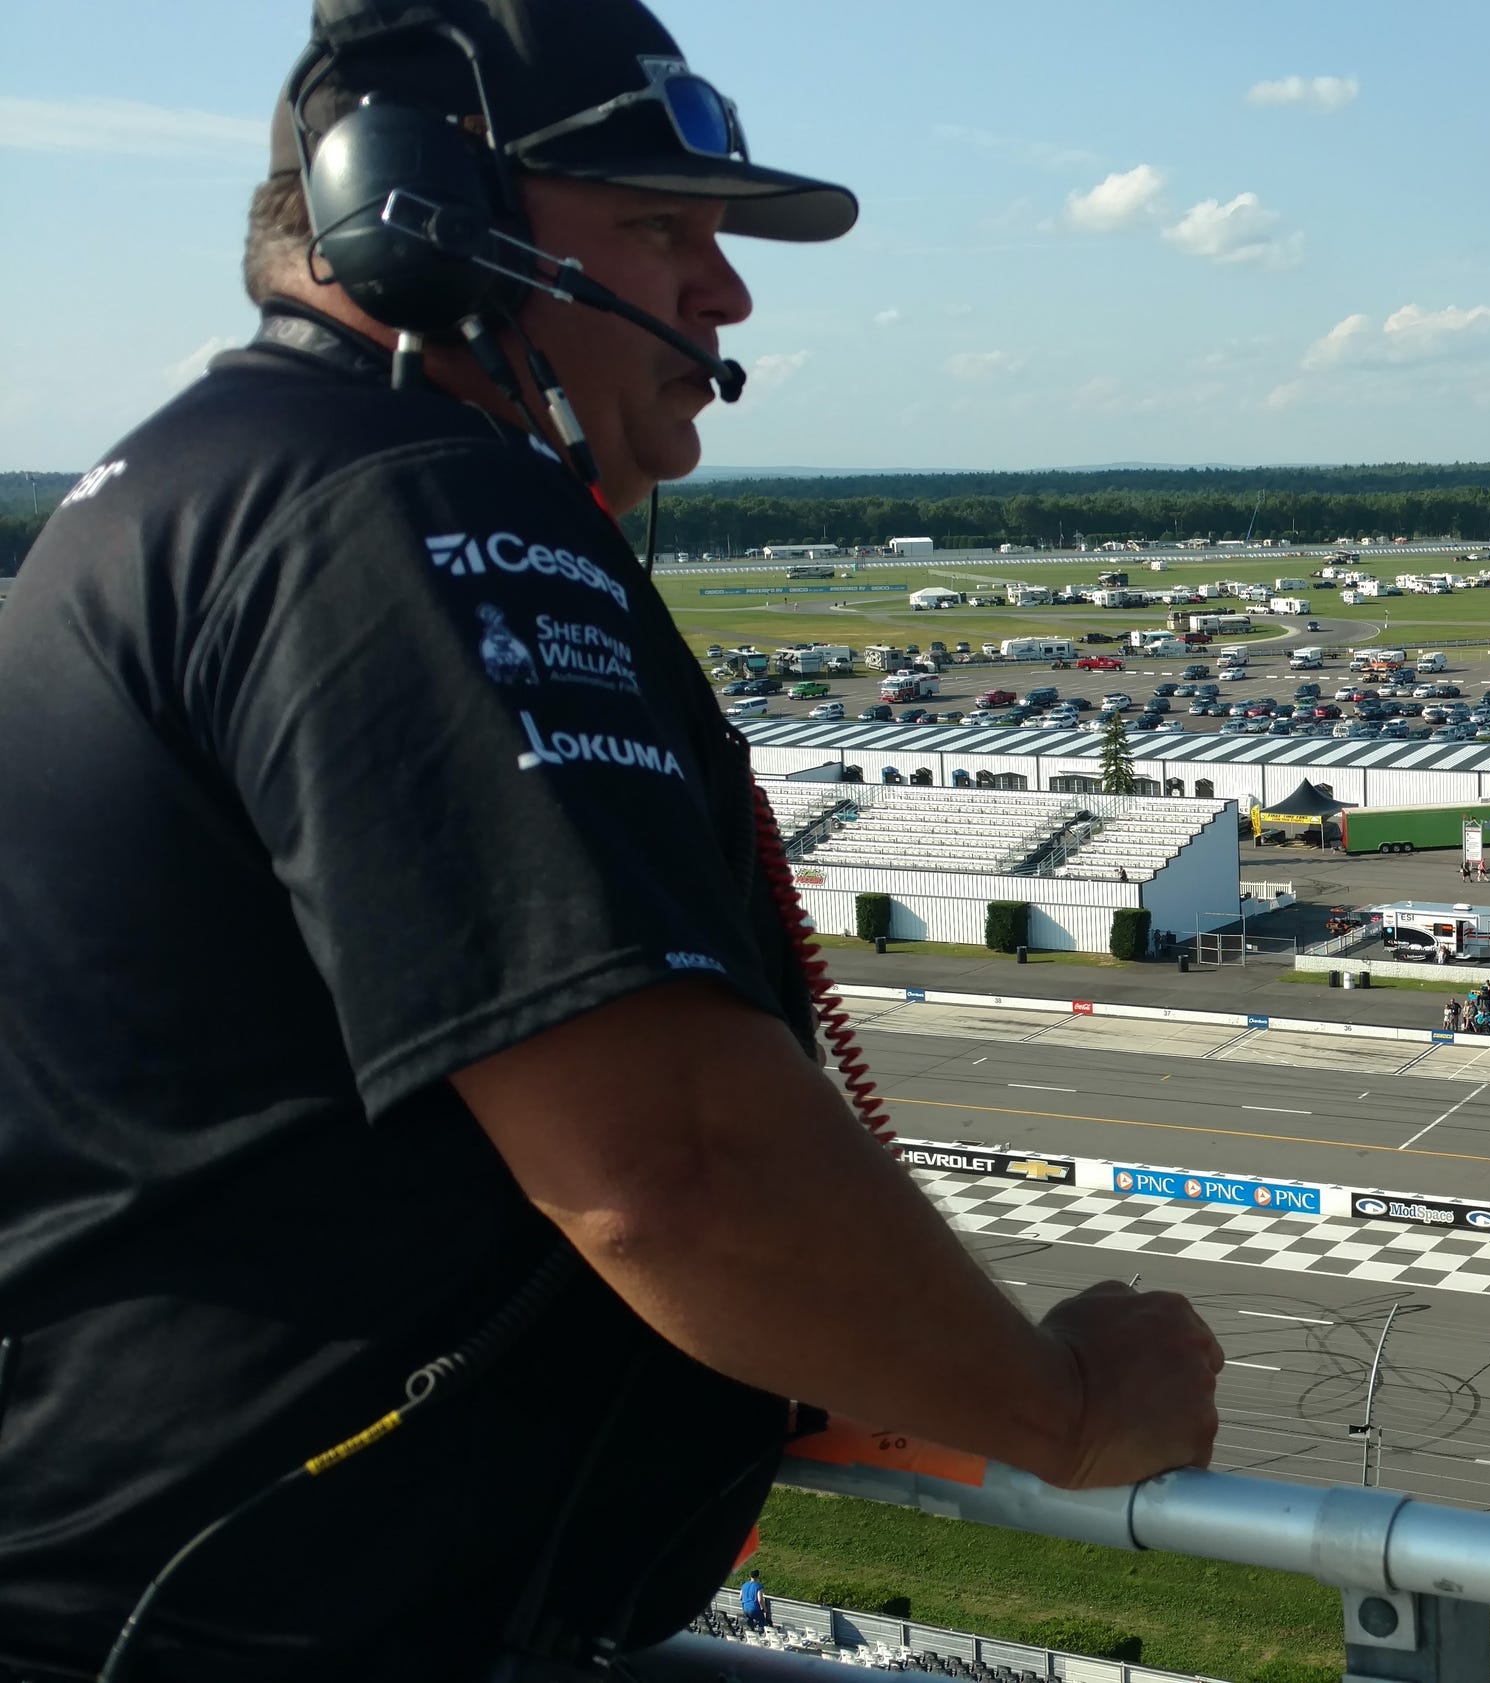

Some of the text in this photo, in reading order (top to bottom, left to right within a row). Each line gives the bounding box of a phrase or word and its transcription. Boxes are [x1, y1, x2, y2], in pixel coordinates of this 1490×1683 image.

[486, 531, 630, 613] Cessna
[1400, 913, 1415, 921] ESI
[1136, 1174, 1315, 1210] PNC PNC PNC
[1389, 1202, 1454, 1224] ModSpace
